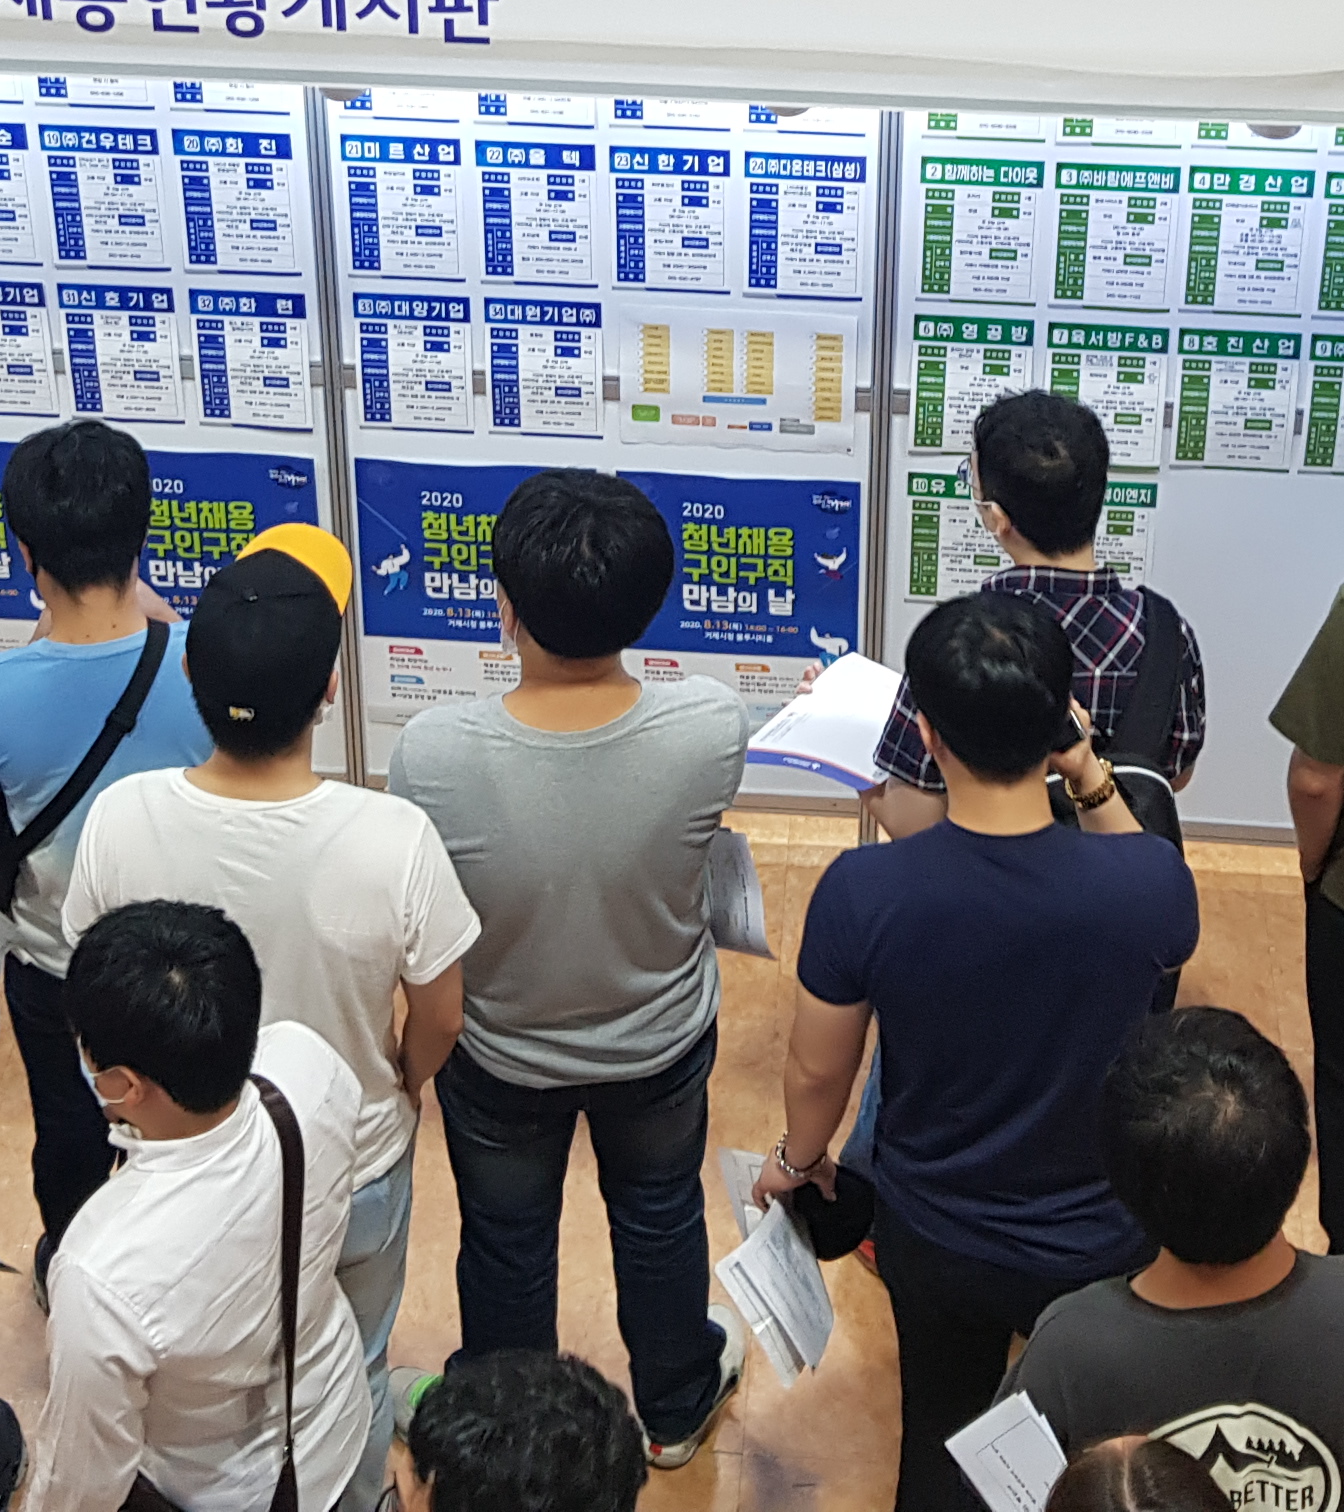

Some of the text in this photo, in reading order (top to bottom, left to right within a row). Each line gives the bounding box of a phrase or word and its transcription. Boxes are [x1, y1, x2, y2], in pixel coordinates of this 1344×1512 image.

[632, 152, 724, 173] 신한기업
[944, 163, 995, 183] 함께하는
[148, 498, 256, 531] 청년채용
[420, 491, 464, 509] 2020
[682, 501, 725, 519] 2020
[681, 521, 795, 556] 청년채용
[424, 571, 498, 601] 만남의
[681, 554, 795, 587] 구인구직
[681, 583, 796, 618] 만남의 날
[1229, 1478, 1315, 1511] BETTER
